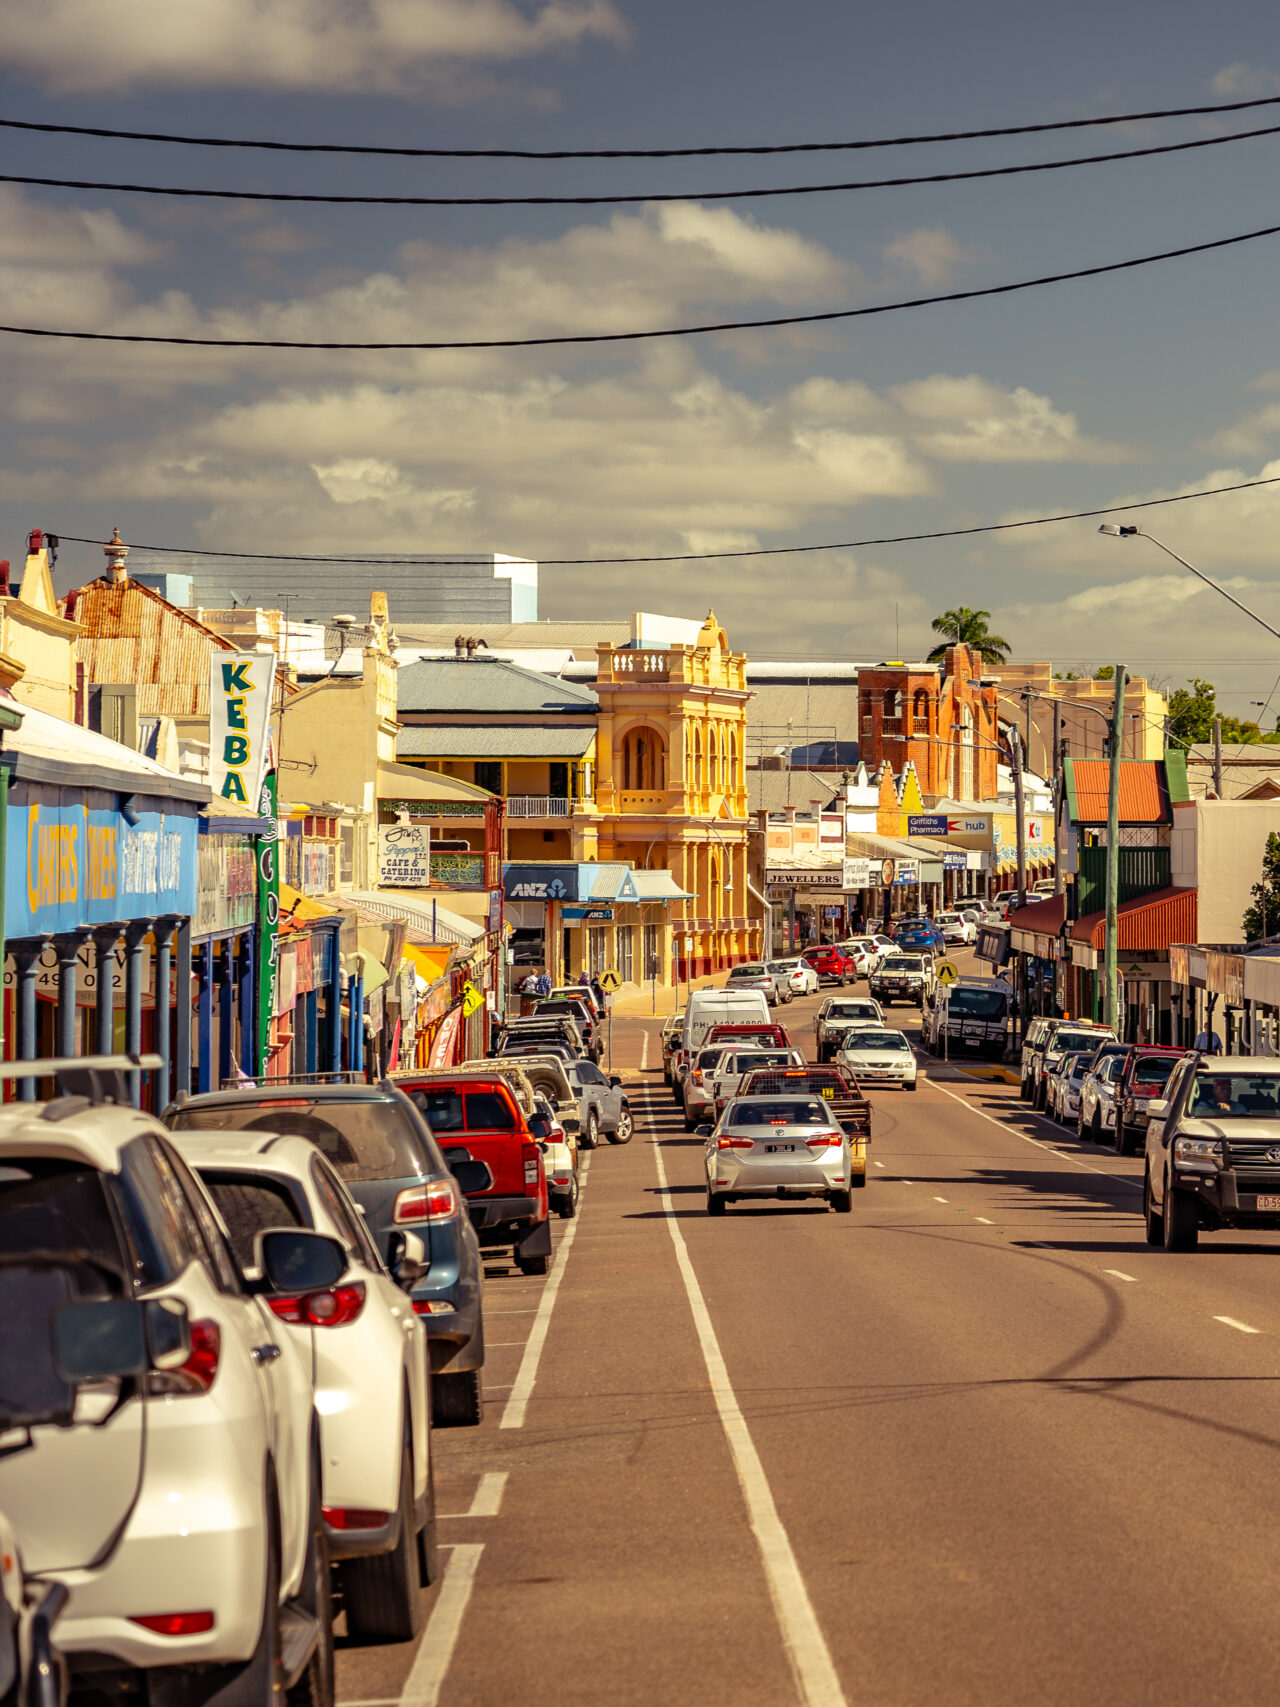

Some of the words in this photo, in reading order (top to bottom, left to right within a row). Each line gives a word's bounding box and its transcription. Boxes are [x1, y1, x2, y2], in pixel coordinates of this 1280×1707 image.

[221, 661, 256, 804] KEBA
[910, 818, 938, 826] Griffiths
[965, 821, 985, 831] hub
[910, 826, 945, 835] Pharmacy
[27, 801, 78, 914] CHARTERS
[381, 867, 426, 876] CATERING
[770, 875, 839, 883] JEWELLERS
[510, 883, 547, 897] ANZ
[693, 1021, 709, 1029] PH:
